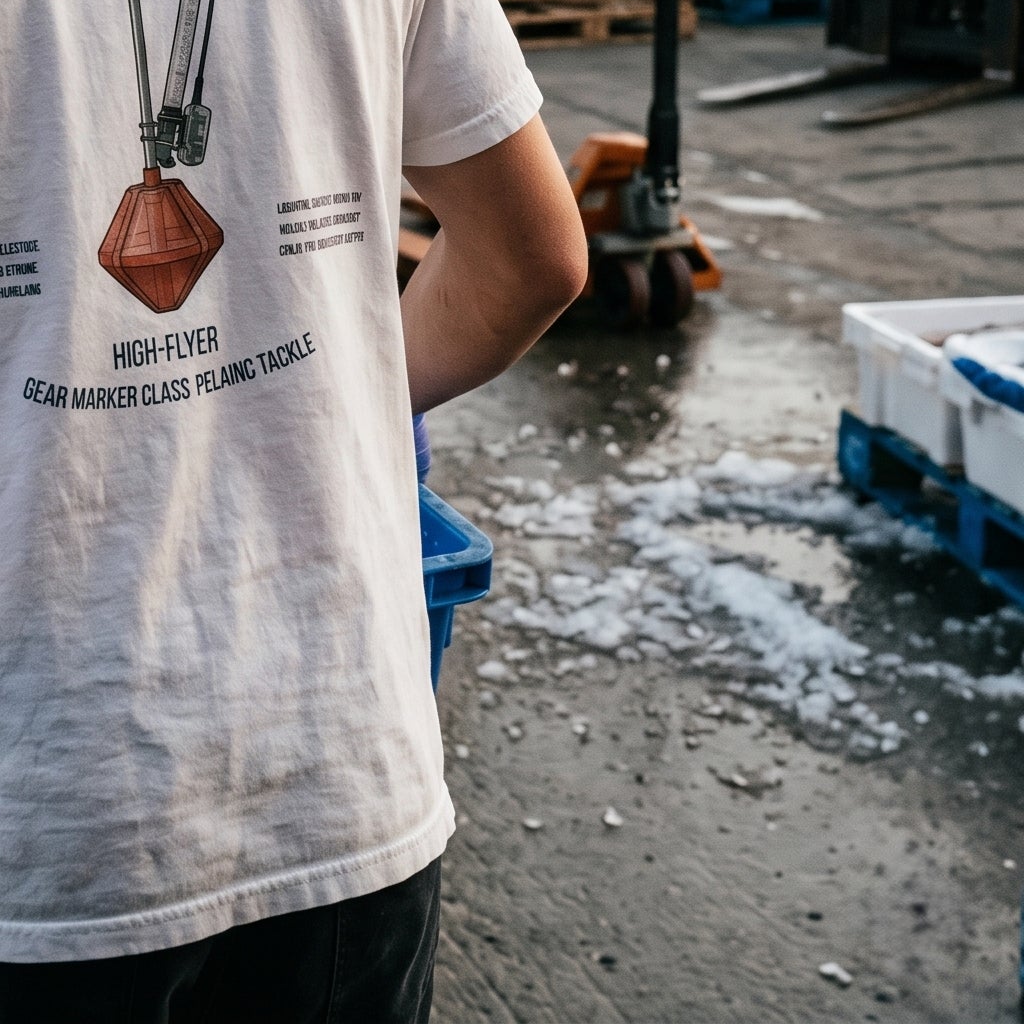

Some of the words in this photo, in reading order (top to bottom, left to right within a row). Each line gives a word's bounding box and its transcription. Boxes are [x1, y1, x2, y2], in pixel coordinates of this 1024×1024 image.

[23, 377, 68, 409] GEAR
[71, 385, 137, 410] MARKER
[141, 377, 191, 407] CLASS
[195, 358, 257, 396] PELAINC
[256, 331, 316, 376] TACKLE
[112, 325, 219, 370] HIGH-FLYER
